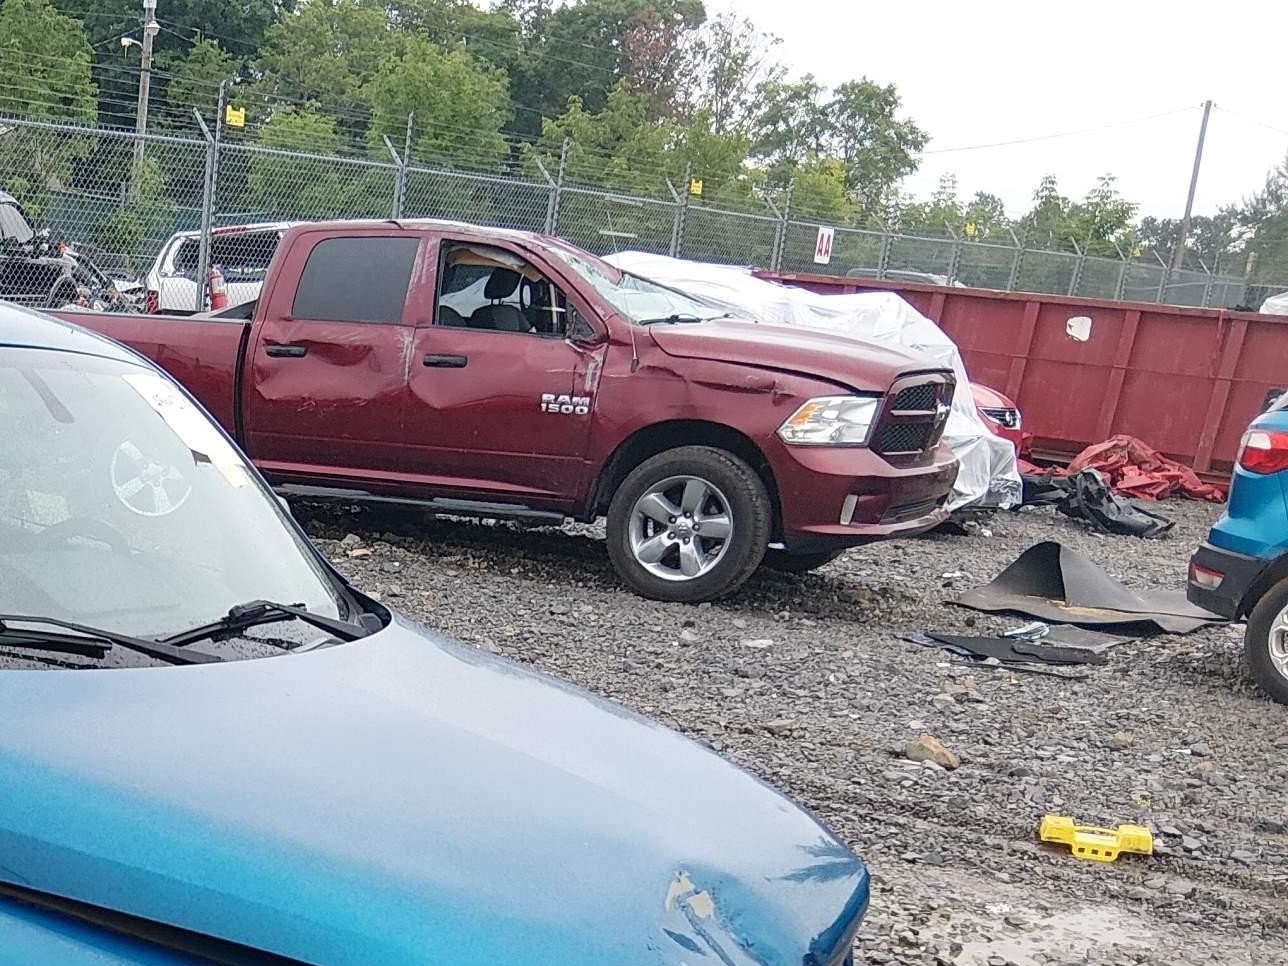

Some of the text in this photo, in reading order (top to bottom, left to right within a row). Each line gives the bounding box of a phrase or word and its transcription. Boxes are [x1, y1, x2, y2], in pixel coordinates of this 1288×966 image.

[816, 233, 831, 257] AA
[541, 394, 590, 406] RAM
[540, 403, 589, 415] 1500
